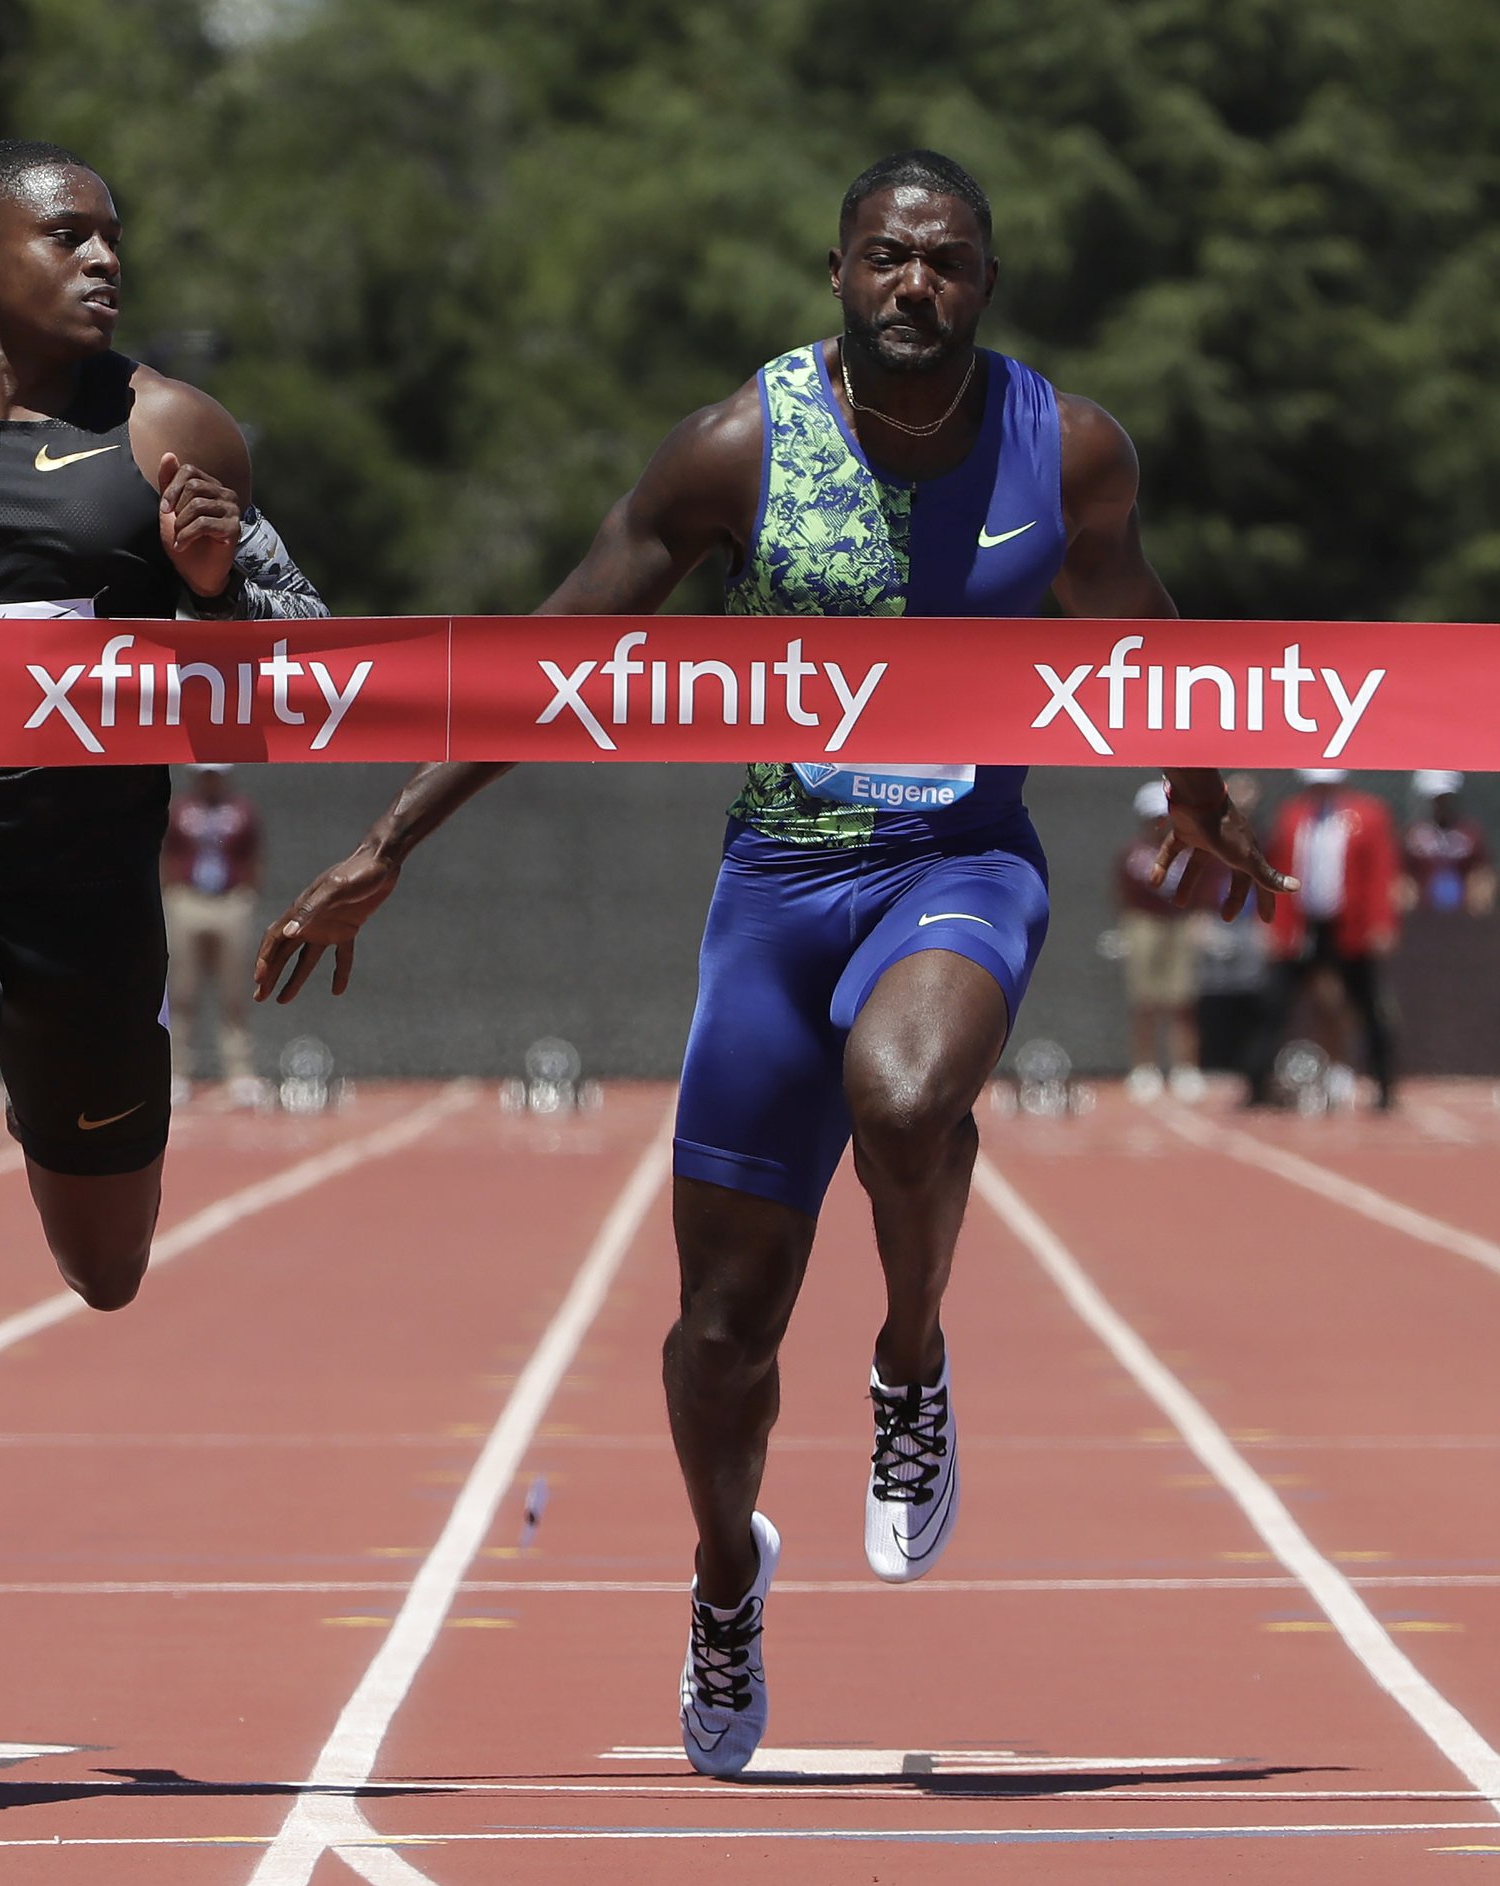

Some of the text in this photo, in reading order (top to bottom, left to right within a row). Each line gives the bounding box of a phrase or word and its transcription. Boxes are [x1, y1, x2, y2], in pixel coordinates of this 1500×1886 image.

[23, 634, 374, 753] xfinity
[535, 631, 888, 752] xfinity
[1030, 635, 1387, 759] xfinity
[851, 774, 955, 805] Eugene
